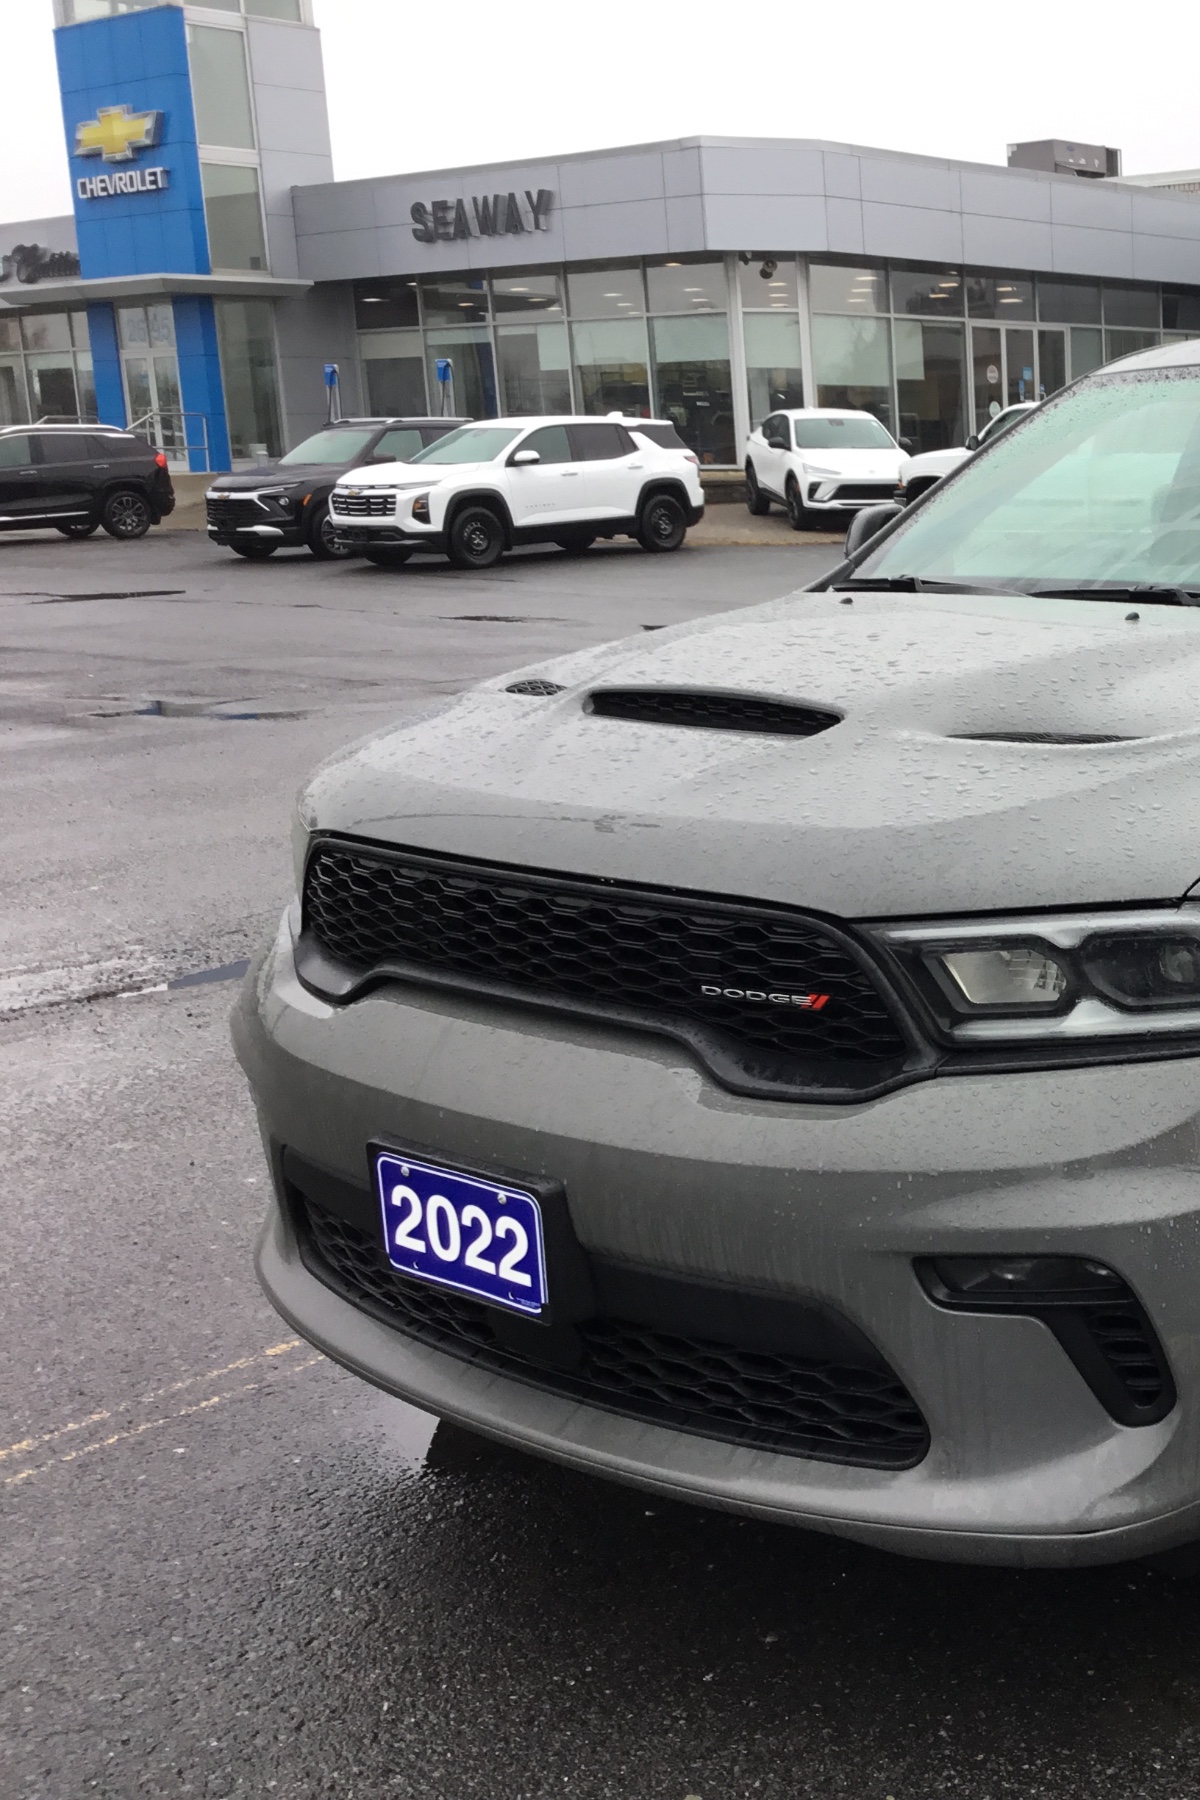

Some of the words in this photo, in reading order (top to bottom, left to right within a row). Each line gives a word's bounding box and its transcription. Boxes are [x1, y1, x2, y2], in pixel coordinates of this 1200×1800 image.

[77, 167, 165, 199] CHEVROLET
[410, 189, 552, 243] SEAWAY
[701, 985, 813, 1006] DODGE
[391, 1184, 532, 1288] 2022
